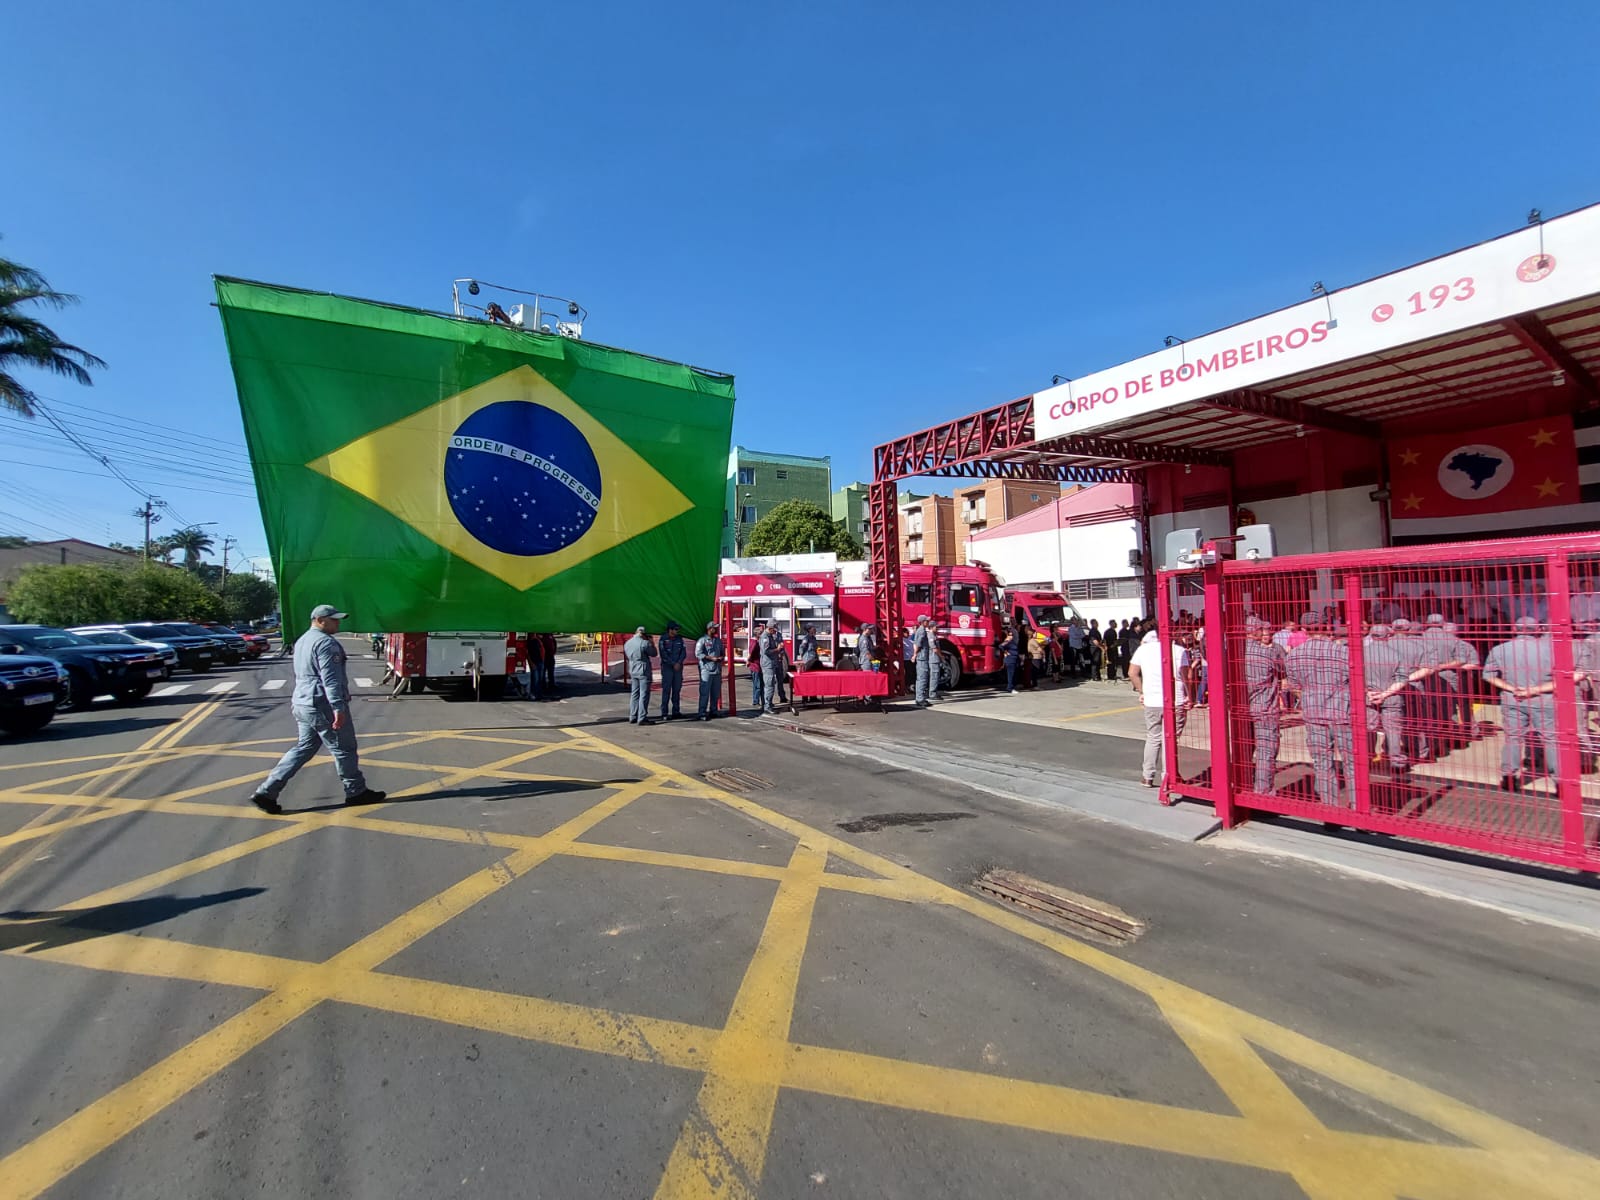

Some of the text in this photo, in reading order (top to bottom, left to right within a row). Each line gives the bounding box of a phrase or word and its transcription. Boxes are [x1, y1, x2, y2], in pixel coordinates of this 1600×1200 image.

[1049, 276, 1476, 420] CORPO DE BOMBEIROS 193
[454, 437, 599, 507] ORDEM E PROGRESSO
